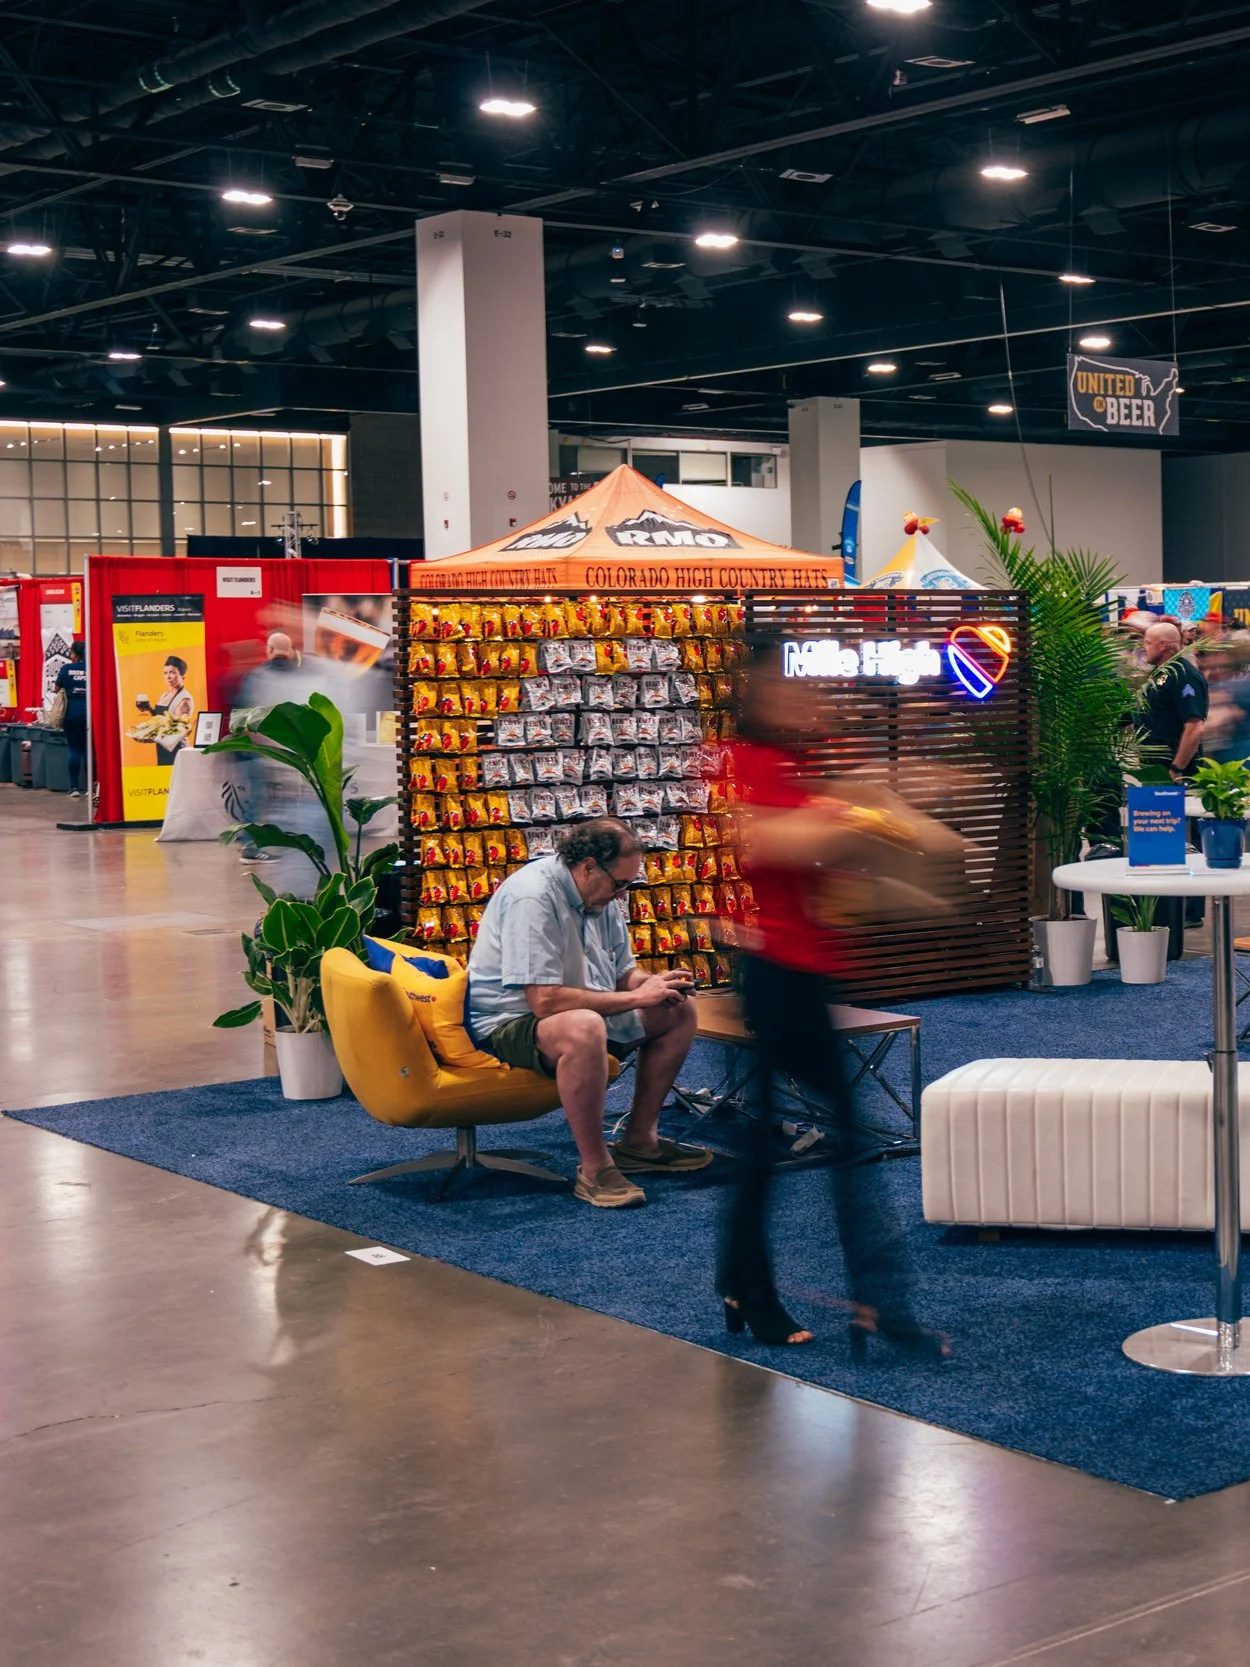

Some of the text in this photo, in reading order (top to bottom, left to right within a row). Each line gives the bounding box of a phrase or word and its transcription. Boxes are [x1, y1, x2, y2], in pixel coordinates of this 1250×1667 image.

[493, 229, 512, 239] E-32
[1077, 371, 1136, 397] UNITED
[1106, 397, 1156, 427] BEER
[507, 531, 588, 549] RMO
[615, 530, 729, 547] RMO
[420, 567, 558, 589] COLORADO HIGH COUNTRY HATS
[586, 566, 828, 589] COLORADO HIGH COUNTRY HATS
[116, 604, 175, 612] VISITFLANDERS
[783, 640, 942, 685] Mile High
[1158, 825, 1175, 833] help.
[1166, 817, 1181, 825] trip?
